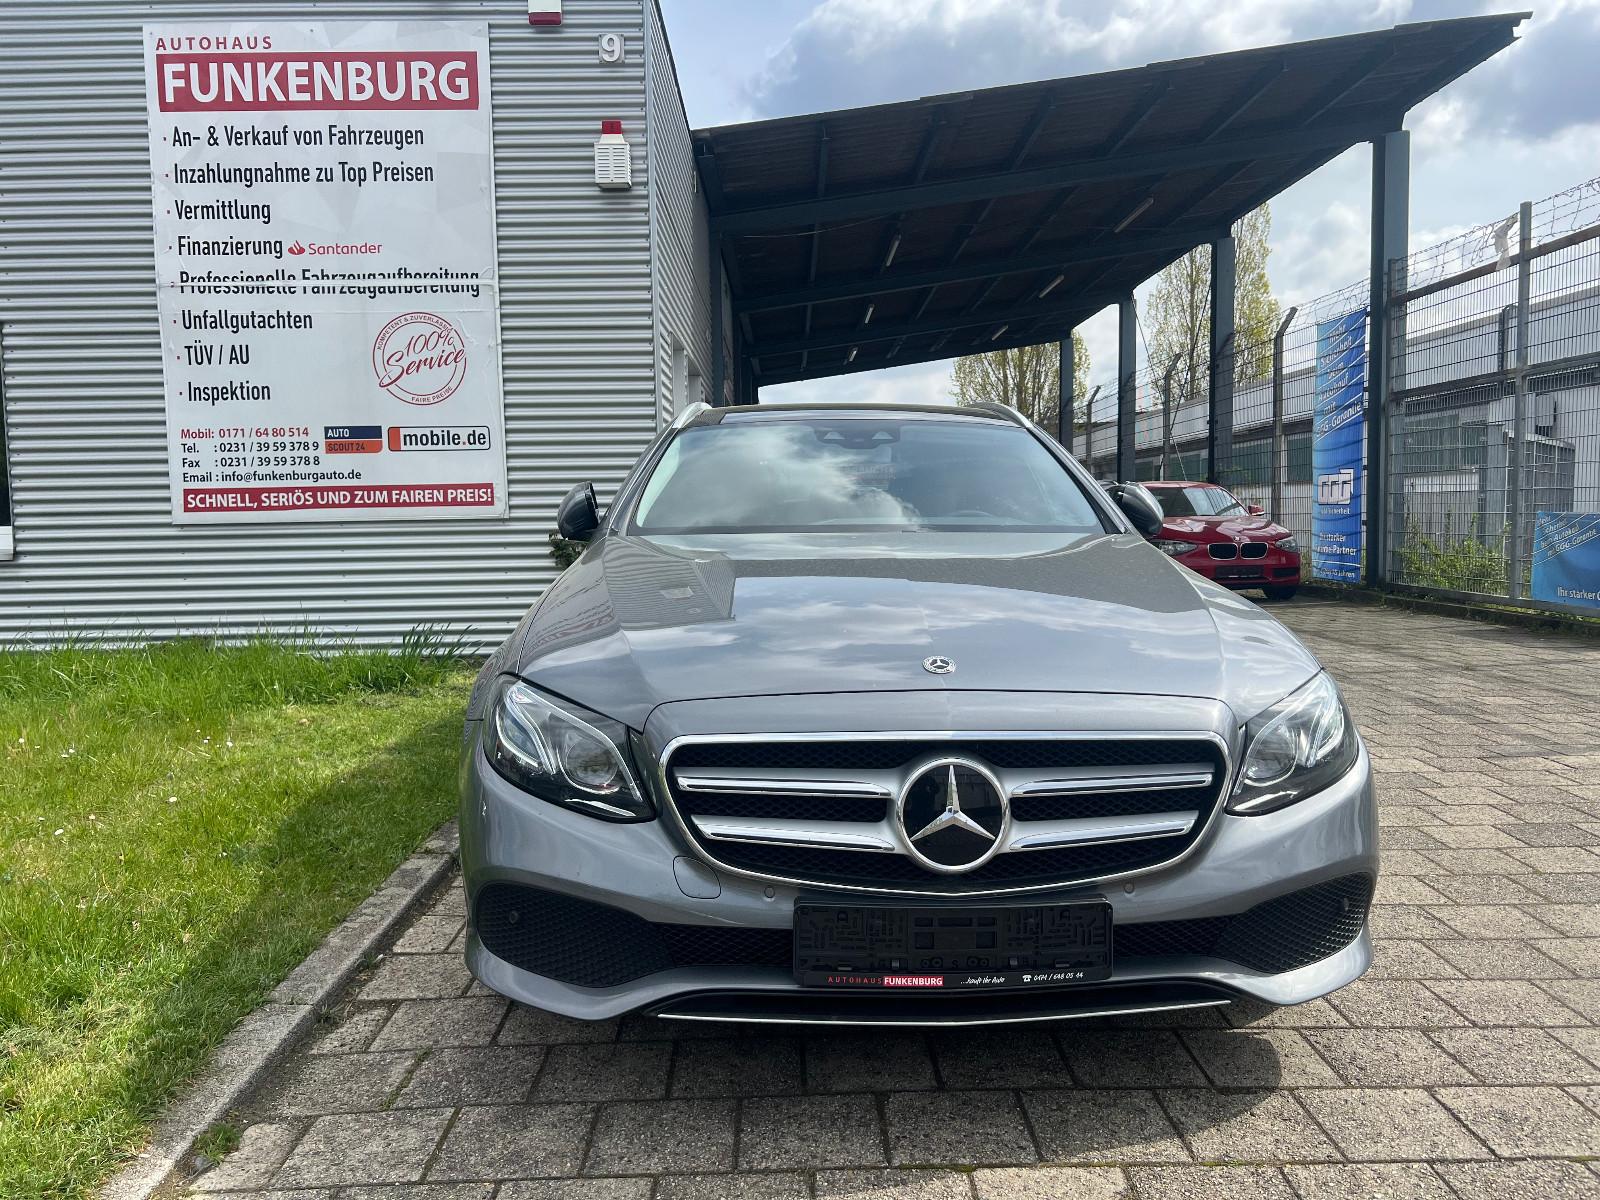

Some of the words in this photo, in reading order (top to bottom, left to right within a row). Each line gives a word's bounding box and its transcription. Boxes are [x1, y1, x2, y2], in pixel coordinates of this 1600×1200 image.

[156, 36, 272, 50] AUTOHAUS
[601, 34, 621, 62] 9
[163, 61, 470, 103] FUNKENBURG
[172, 126, 200, 147] An-
[207, 126, 220, 146] &
[224, 125, 288, 146] Verkauf
[293, 130, 323, 146] von
[328, 124, 424, 150] Fahrzeugen
[174, 162, 310, 188] Inzahlungnahme
[315, 167, 334, 183] zu
[338, 161, 367, 187] Top
[372, 161, 434, 182] Preisen
[174, 199, 271, 225] Vermittlung
[178, 235, 283, 260] Finanzierung
[308, 242, 382, 255] Santander
[179, 269, 297, 295] Professionelle
[301, 267, 480, 299] Fahrzeugaufbereitung
[181, 309, 313, 333] Unfallgutachten
[184, 339, 213, 366] TÜV
[218, 344, 224, 365] /
[229, 344, 250, 365] AU
[404, 328, 454, 357] 100%
[379, 349, 465, 388] Service
[187, 380, 271, 405] Inspektion
[181, 427, 214, 439] Mobil:
[219, 428, 245, 439] 0171
[249, 427, 253, 438] /
[255, 427, 269, 438] 64
[272, 427, 285, 437] 80
[288, 427, 309, 437] 514
[327, 428, 350, 438] AUTO
[403, 429, 487, 446] mobile.de
[181, 443, 200, 453] Tel.
[219, 442, 246, 453] 0231
[250, 442, 254, 452] /
[256, 442, 270, 452] 39
[273, 441, 286, 451] 59
[289, 441, 310, 451] 378
[312, 441, 319, 451] 9
[182, 457, 201, 468] Fax
[220, 456, 247, 467] 0231
[251, 456, 255, 467] /
[257, 456, 271, 467] 39
[273, 456, 287, 466] 59
[290, 456, 311, 466] 378
[313, 456, 320, 466] 8
[183, 471, 213, 483] Email
[221, 469, 361, 483] info@funkenburgauto.de
[187, 493, 258, 508] SCHNELL,
[261, 490, 313, 507] SERIÖS
[317, 491, 350, 505] UND
[354, 490, 387, 504] ZUM
[392, 489, 444, 503] FAIREN
[447, 488, 492, 502] PREIS!
[1569, 589, 1596, 600] starker
[827, 976, 882, 985] AUTOHAUS
[884, 976, 943, 986] FUNKENBURG
